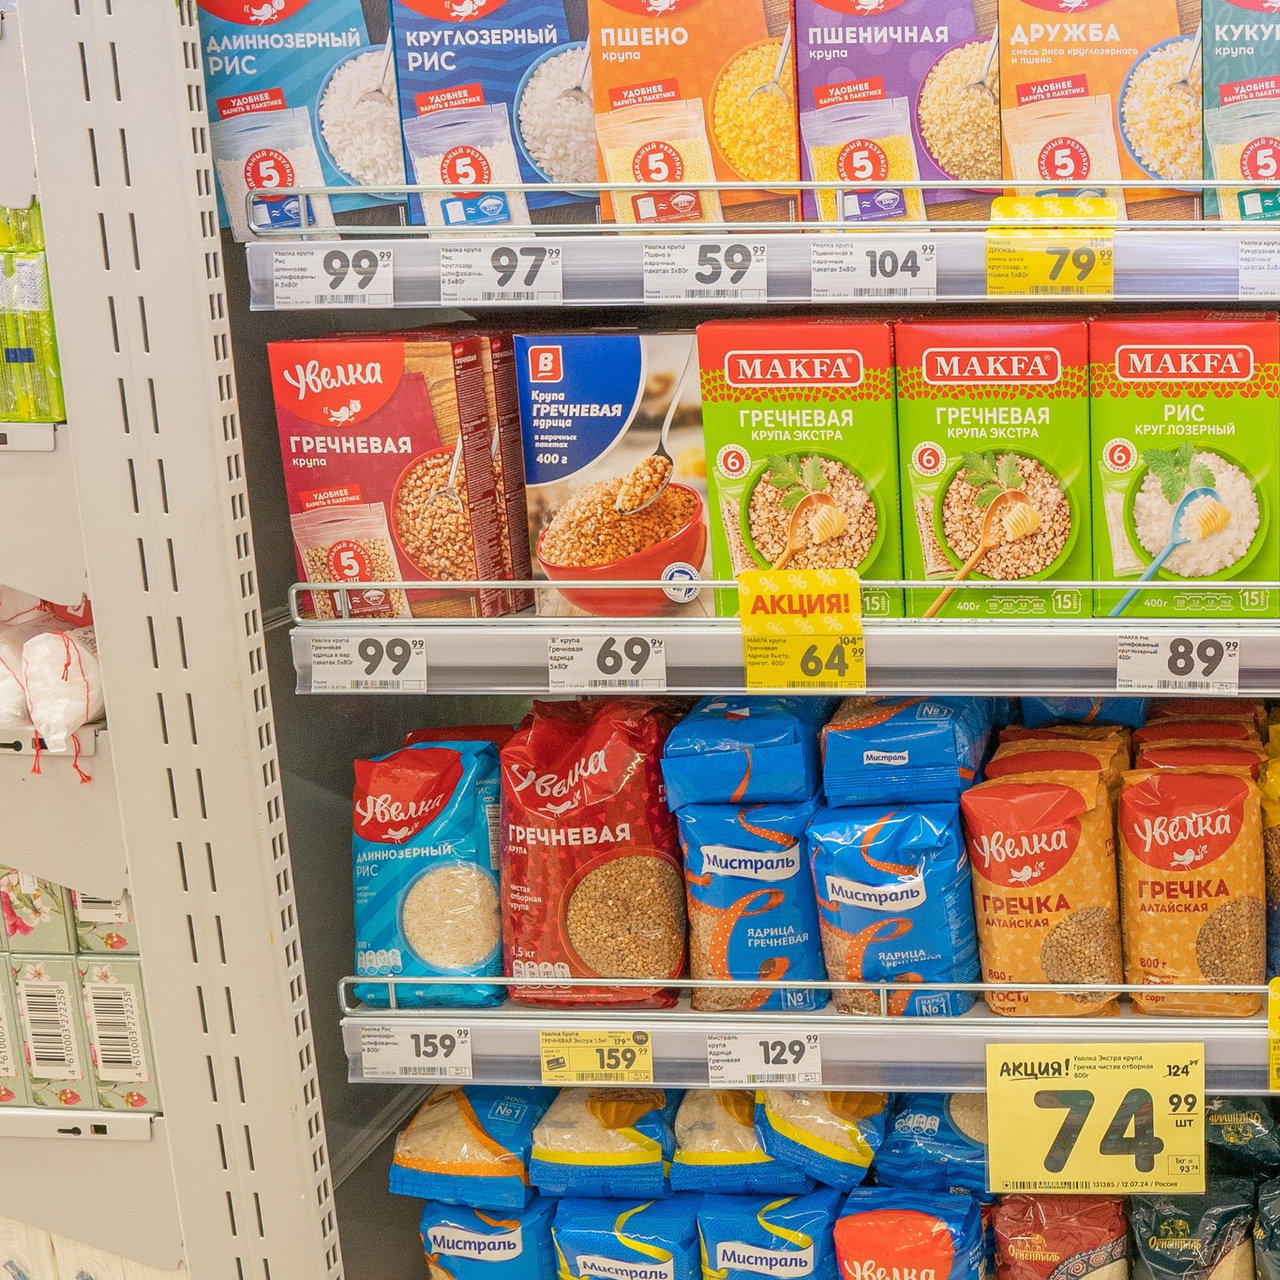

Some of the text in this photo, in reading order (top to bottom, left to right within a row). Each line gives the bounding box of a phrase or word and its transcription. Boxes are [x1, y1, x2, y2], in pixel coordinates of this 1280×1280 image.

[206, 27, 361, 53] ДЛИННОЗЕРНЫЙ
[406, 25, 558, 46] КРУГЛОЗЕРНЫЙ
[601, 27, 689, 46] ПШЕНО
[808, 26, 949, 44] ПШЕНИЧНАЯ
[1010, 23, 1121, 45] ДРУЖБА
[209, 55, 257, 75] РИС
[407, 51, 457, 71] РИС
[602, 50, 641, 62] крупа
[230, 92, 270, 107] УДОБНЕЕ
[322, 250, 379, 290] 99
[490, 247, 547, 287] 97
[695, 244, 753, 285] 59
[865, 250, 920, 279] 104
[1045, 246, 1097, 282] 79
[738, 358, 851, 379] MAKFA
[1128, 353, 1242, 374] MAKFA
[532, 403, 622, 417] ГРЕЧНЕВАЯ
[739, 409, 853, 428] ГРЕЧНЕВАЯ
[1163, 404, 1205, 422] РИС
[751, 429, 843, 441] КРУПА ЭКСТРА
[1135, 422, 1236, 436] КРУГЛОЗЕРНЫЙ
[289, 436, 413, 454] ГРЕЧНЕВАЯ
[535, 453, 559, 465] 400
[750, 593, 850, 617] АКЦИЯ!
[357, 638, 412, 675] 99
[596, 637, 651, 675] 69
[800, 644, 849, 677] 64
[1167, 638, 1225, 677] 89
[508, 823, 630, 846] ГРЕЧНЕВАЯ
[830, 886, 920, 904] Мистраль
[981, 894, 1071, 914] ГРЕЧКА
[985, 917, 1050, 929] АЛТАЙСКАЯ
[410, 1034, 456, 1058] 159
[759, 1041, 805, 1064] 129
[999, 1058, 1070, 1080] АКЦИЯ!
[1119, 1063, 1153, 1071] отборная
[1034, 1089, 1164, 1173] 74
[432, 1235, 517, 1252] Мистраль
